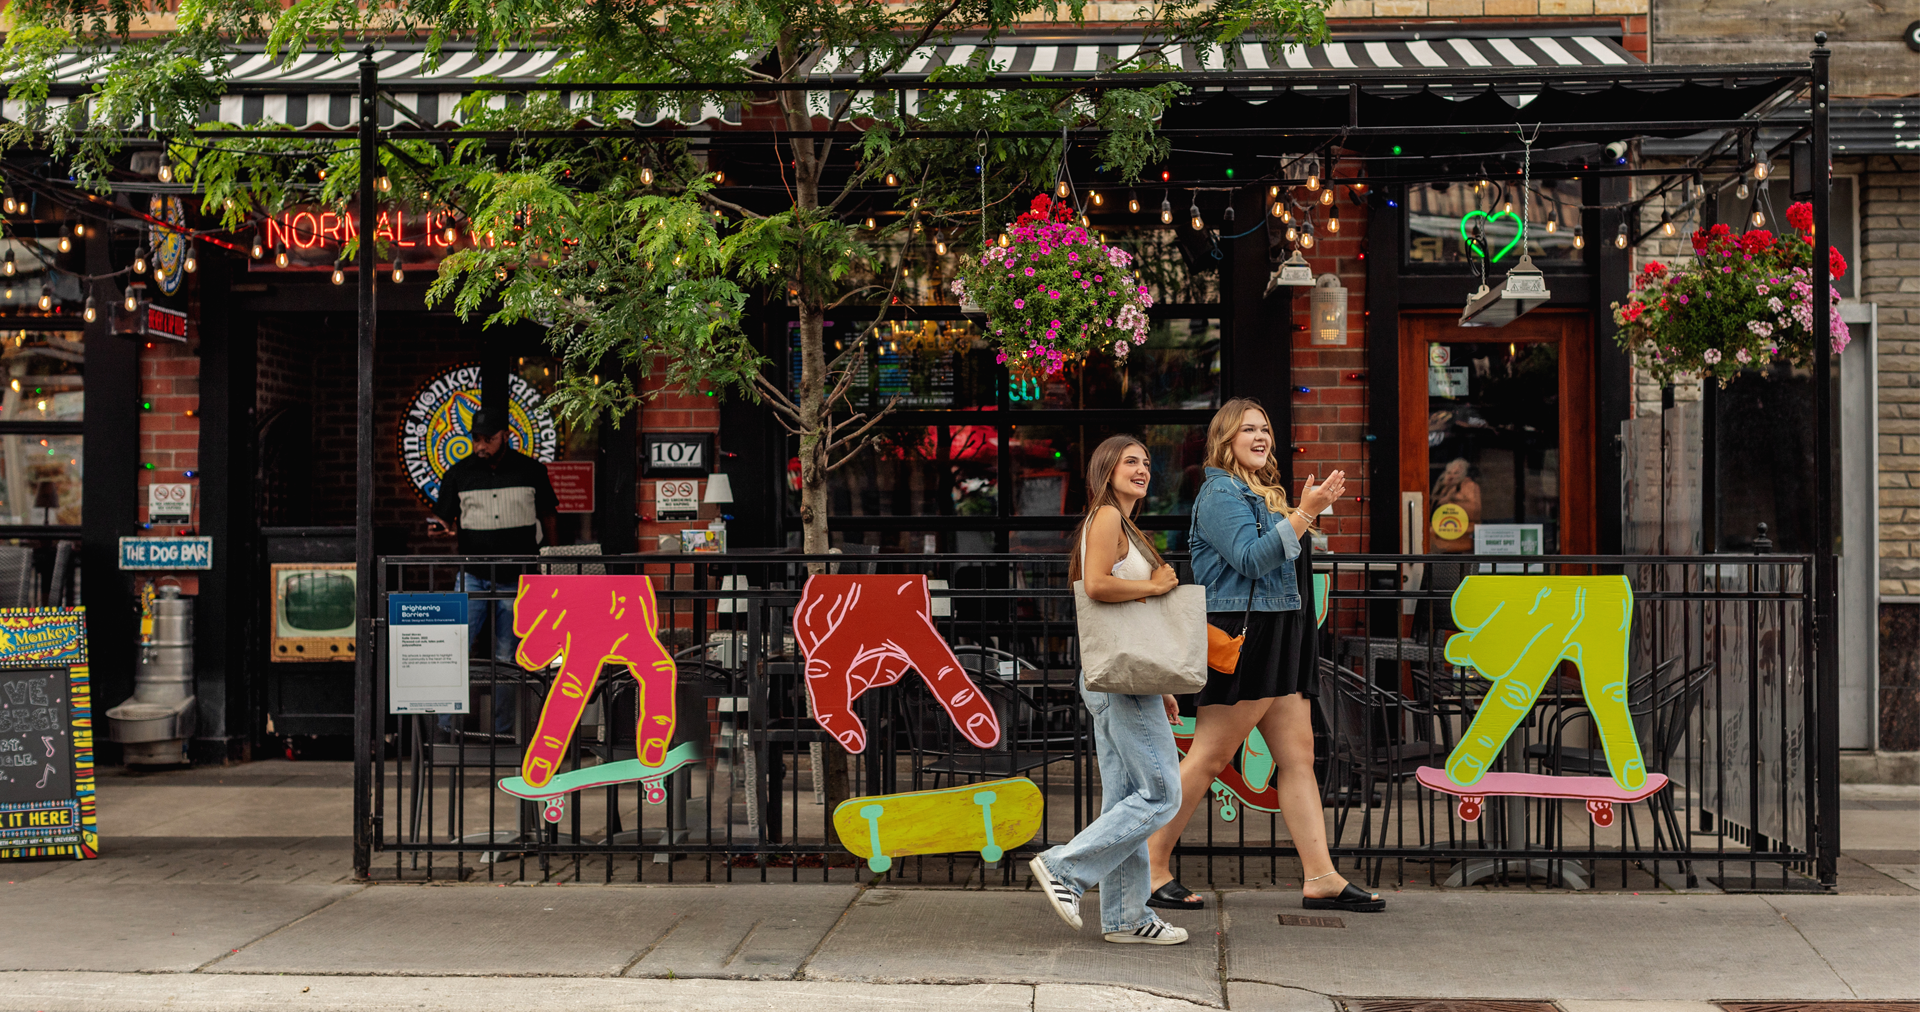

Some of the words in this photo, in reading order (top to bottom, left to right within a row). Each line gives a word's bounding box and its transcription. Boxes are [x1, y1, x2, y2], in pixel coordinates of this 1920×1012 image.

[409, 366, 482, 422] Monkey
[508, 373, 542, 408] raft
[403, 419, 431, 490] Flying
[652, 443, 700, 462] 107
[125, 544, 146, 562] THE
[150, 545, 179, 562] DOG
[181, 543, 207, 563] BAR
[14, 625, 77, 646] Monkeys
[36, 639, 62, 649] BREWERY
[9, 813, 24, 828] IT
[29, 810, 70, 827] HERE
